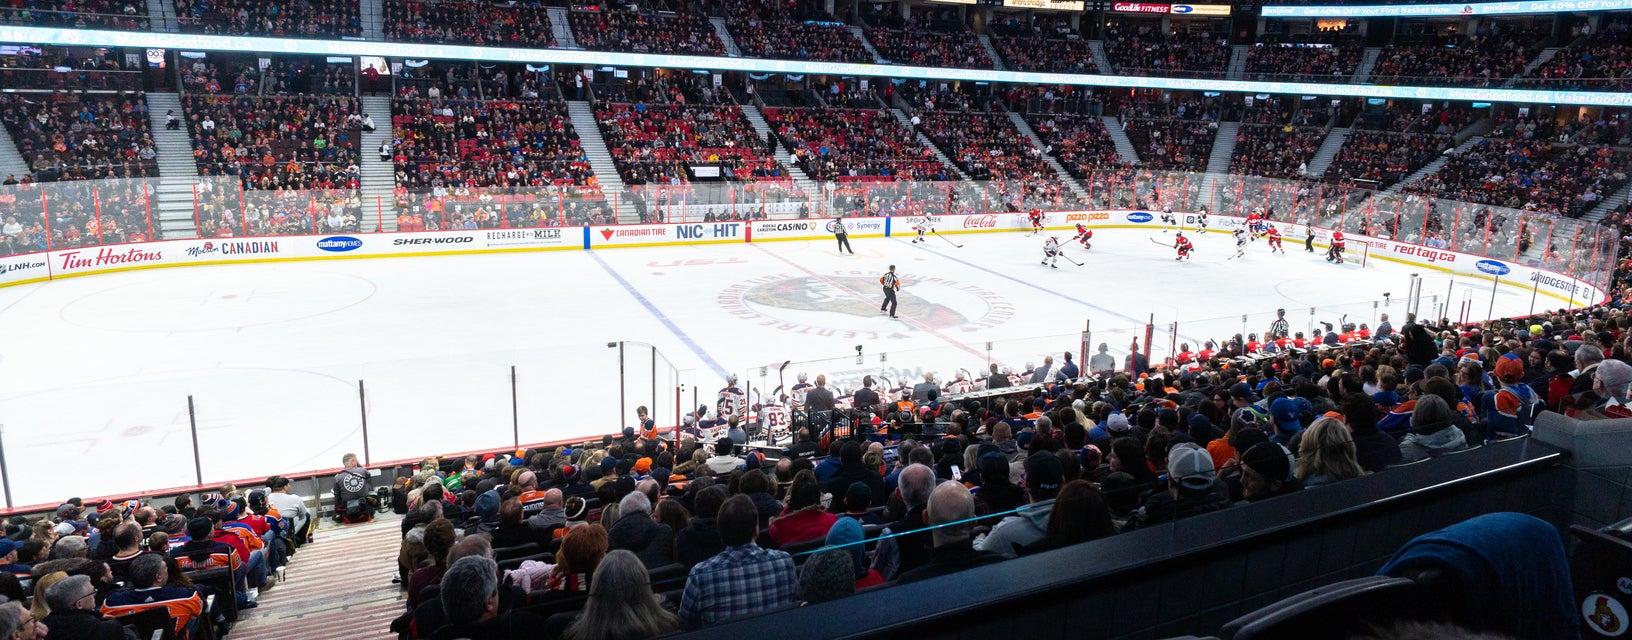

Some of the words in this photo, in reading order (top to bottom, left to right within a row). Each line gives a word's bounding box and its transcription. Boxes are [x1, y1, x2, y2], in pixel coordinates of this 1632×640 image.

[1362, 7, 1379, 15] Your
[1431, 6, 1450, 14] Now
[1551, 2, 1575, 10] 40%
[1577, 1, 1599, 9] OFF
[1601, 0, 1621, 8] Your
[116, 33, 251, 50] MakeGoodfood.ca
[328, 42, 443, 57] MakeGoodfood.ca
[509, 50, 610, 64] MakeGoodfood.ca
[667, 58, 756, 70] MakeGoodfood.ca
[805, 63, 883, 75] MakeGoodfood.ca
[926, 69, 998, 81] MakeGoodfood.ca
[1042, 74, 1119, 86] MakeGoodfood.ca
[1166, 79, 1249, 91] MakeGoodfood.ca
[1302, 85, 1392, 97] MakeGoodfood.ca
[1449, 90, 1549, 103] MakeGoodfood.ca
[1066, 213, 1087, 223] pizza
[1088, 212, 1110, 222] pizza
[616, 229, 650, 237] CANADIAN
[714, 223, 740, 237] HIT
[777, 223, 808, 231] CASINO
[487, 230, 526, 239] RECHARGE
[534, 229, 560, 239] MILK
[393, 236, 474, 246] SHER-WOOD
[1374, 241, 1387, 250] TIRE
[222, 241, 279, 254] CANADIAN
[59, 251, 92, 270] Tim
[95, 248, 162, 266] Hortons
[768, 412, 786, 426] 83
